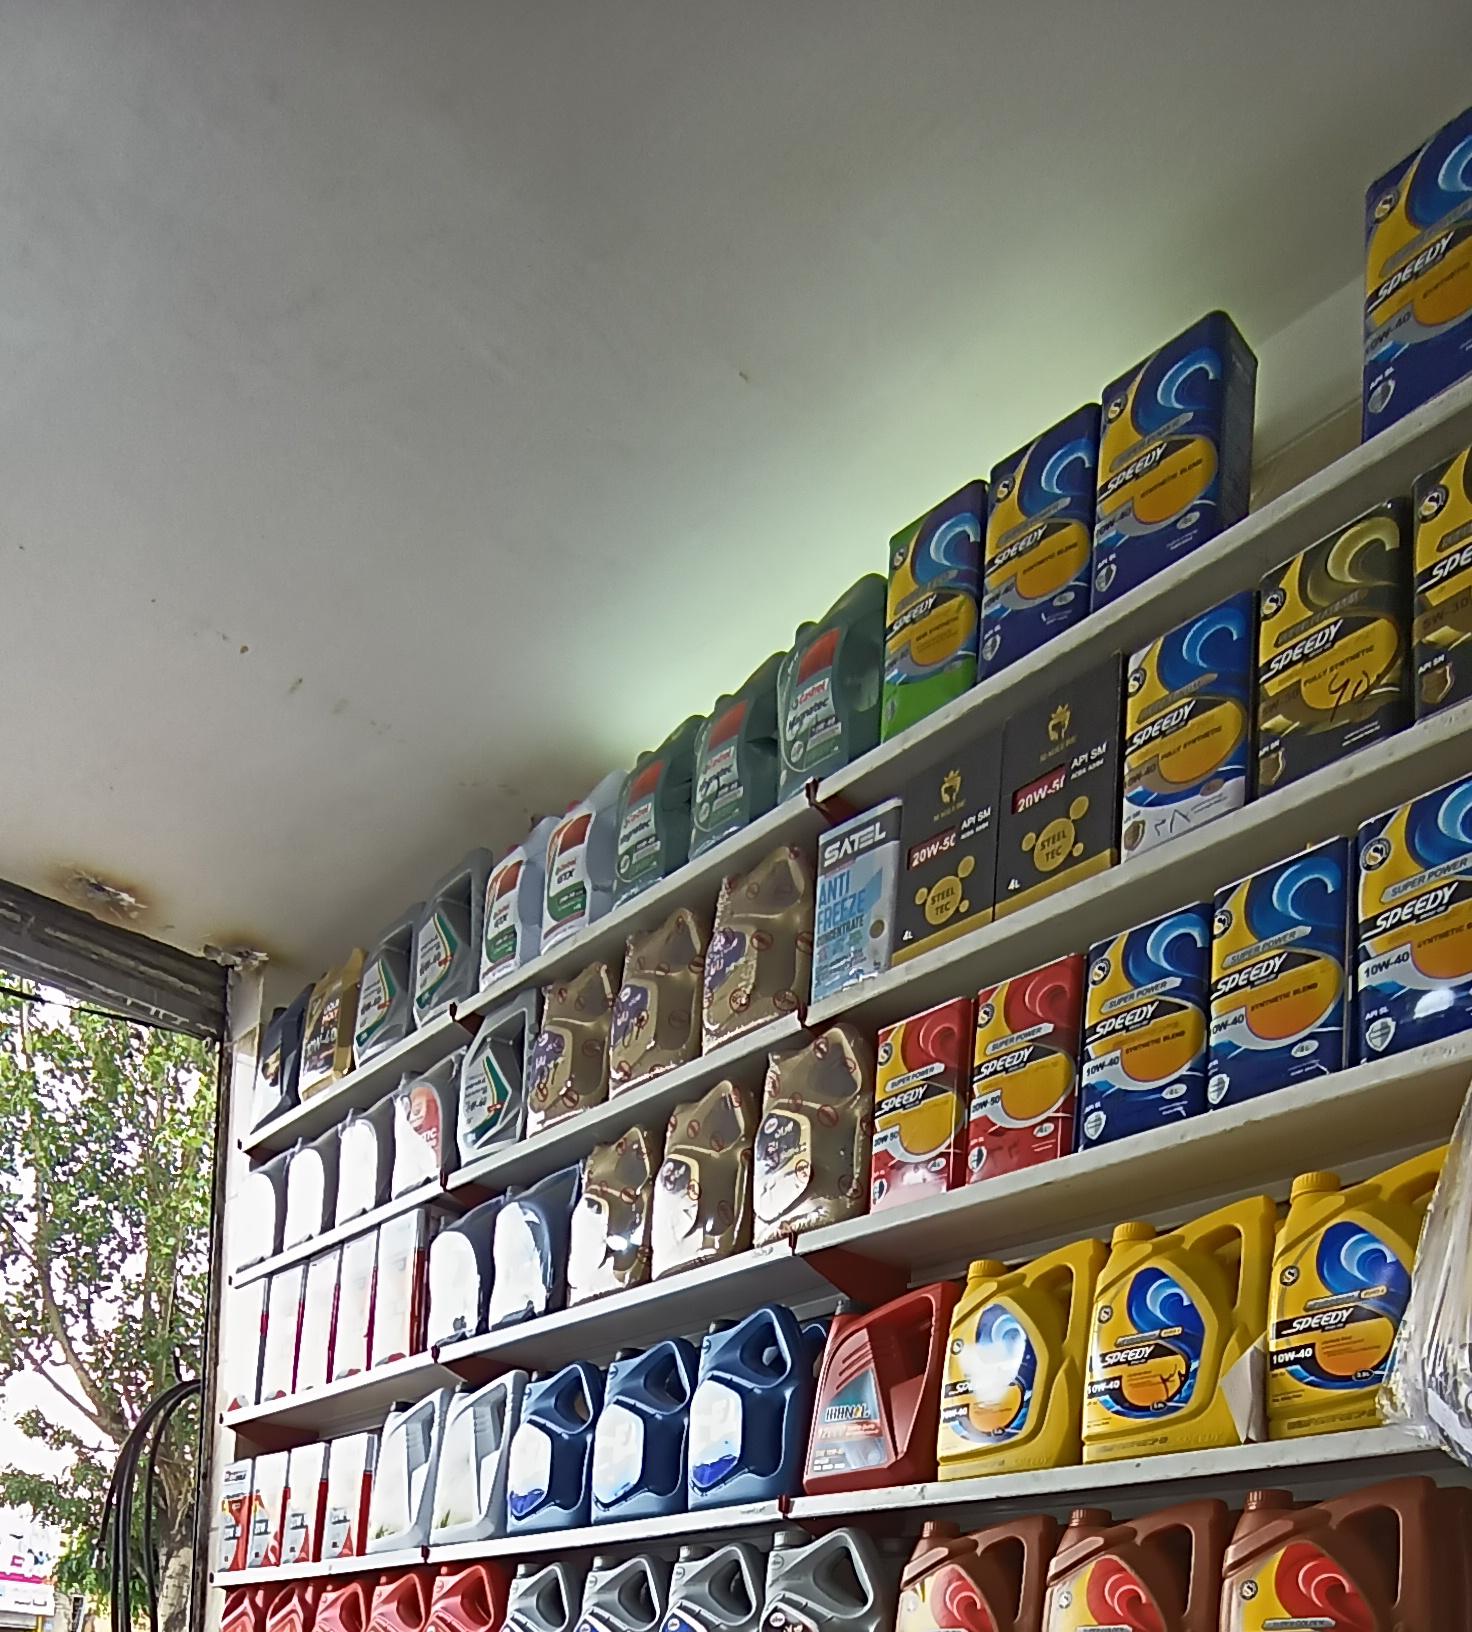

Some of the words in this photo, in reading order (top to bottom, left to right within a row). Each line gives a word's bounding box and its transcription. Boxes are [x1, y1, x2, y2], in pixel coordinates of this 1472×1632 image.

[1368, 231, 1455, 312] SPEEDY
[1098, 443, 1167, 501] SPEEDY
[985, 525, 1047, 576] SPEEDY
[1416, 544, 1472, 593] SPE
[1259, 619, 1343, 683] SPEEDY
[1125, 700, 1195, 755] SPEEDY
[1071, 752, 1089, 770] API
[961, 817, 976, 831] API
[1040, 829, 1067, 850] STEEL
[824, 822, 886, 868] SATEL
[1044, 846, 1061, 862] TEC
[819, 870, 850, 906] ANTI
[1391, 873, 1426, 897] SUPER
[1427, 857, 1469, 883] POWER
[817, 889, 867, 934] FREEZE
[931, 887, 955, 906] STEEL
[935, 903, 951, 916] TEC
[1361, 881, 1459, 939] SPEEDY
[1231, 946, 1262, 963] SUPER
[1263, 930, 1296, 950] POWER
[1417, 925, 1465, 948] SYNTHETIC
[1211, 953, 1288, 1000] SPEEDY
[1364, 951, 1410, 978] 10W-40
[1109, 993, 1135, 1008] SUPER
[1136, 981, 1167, 999] POWER
[991, 1036, 1018, 1051] SUPER
[1019, 1026, 1042, 1042] POWER
[1086, 1001, 1159, 1043] SPEEDY
[1212, 1014, 1245, 1035] 0W-40
[973, 1046, 1034, 1080] SPEEDY
[1086, 1056, 1119, 1076] 10W-40
[875, 1084, 928, 1117] SPEEDY
[1281, 1308, 1354, 1334] SPEEDY
[1102, 1345, 1155, 1366] SPEEDY
[1272, 1348, 1313, 1364] 10W-40
